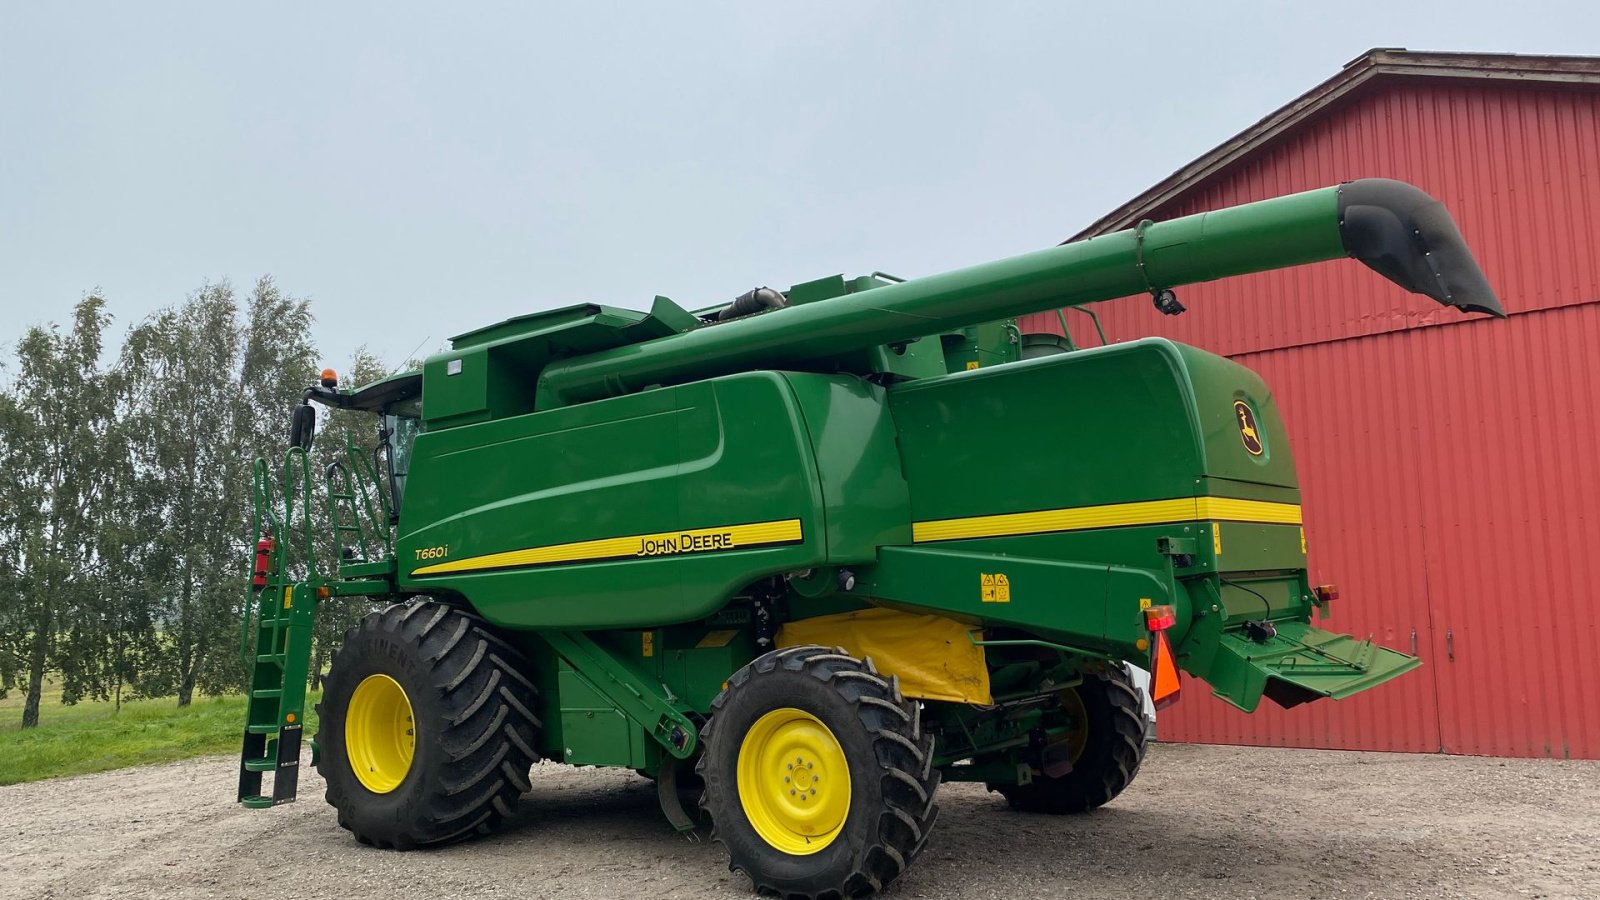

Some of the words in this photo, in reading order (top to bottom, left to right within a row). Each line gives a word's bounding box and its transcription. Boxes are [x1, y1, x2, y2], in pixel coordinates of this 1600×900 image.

[415, 544, 448, 560] T660i
[637, 538, 678, 555] JOHN
[680, 533, 733, 550] DEERE
